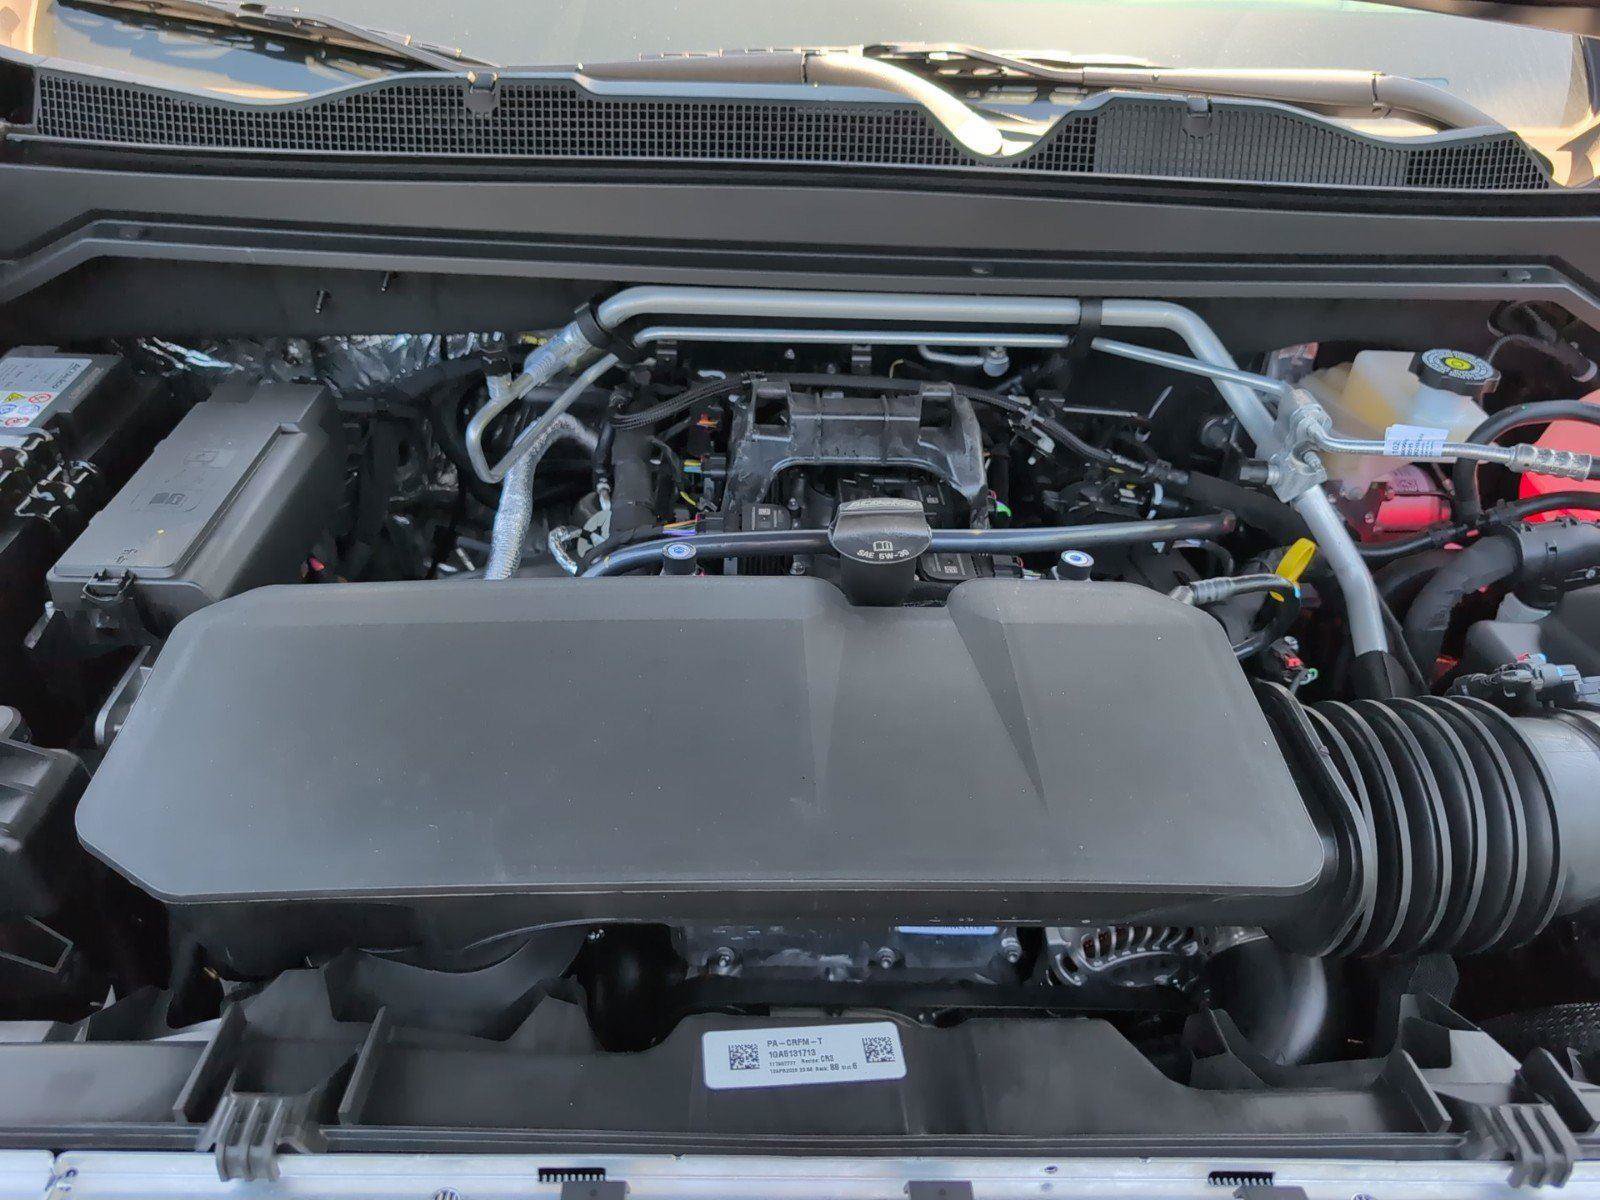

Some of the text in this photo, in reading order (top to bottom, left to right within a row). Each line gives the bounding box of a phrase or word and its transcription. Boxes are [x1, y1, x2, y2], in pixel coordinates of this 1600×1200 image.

[856, 549, 910, 560] SAE 5W-30
[767, 1037, 823, 1046] PA-CRFM-T
